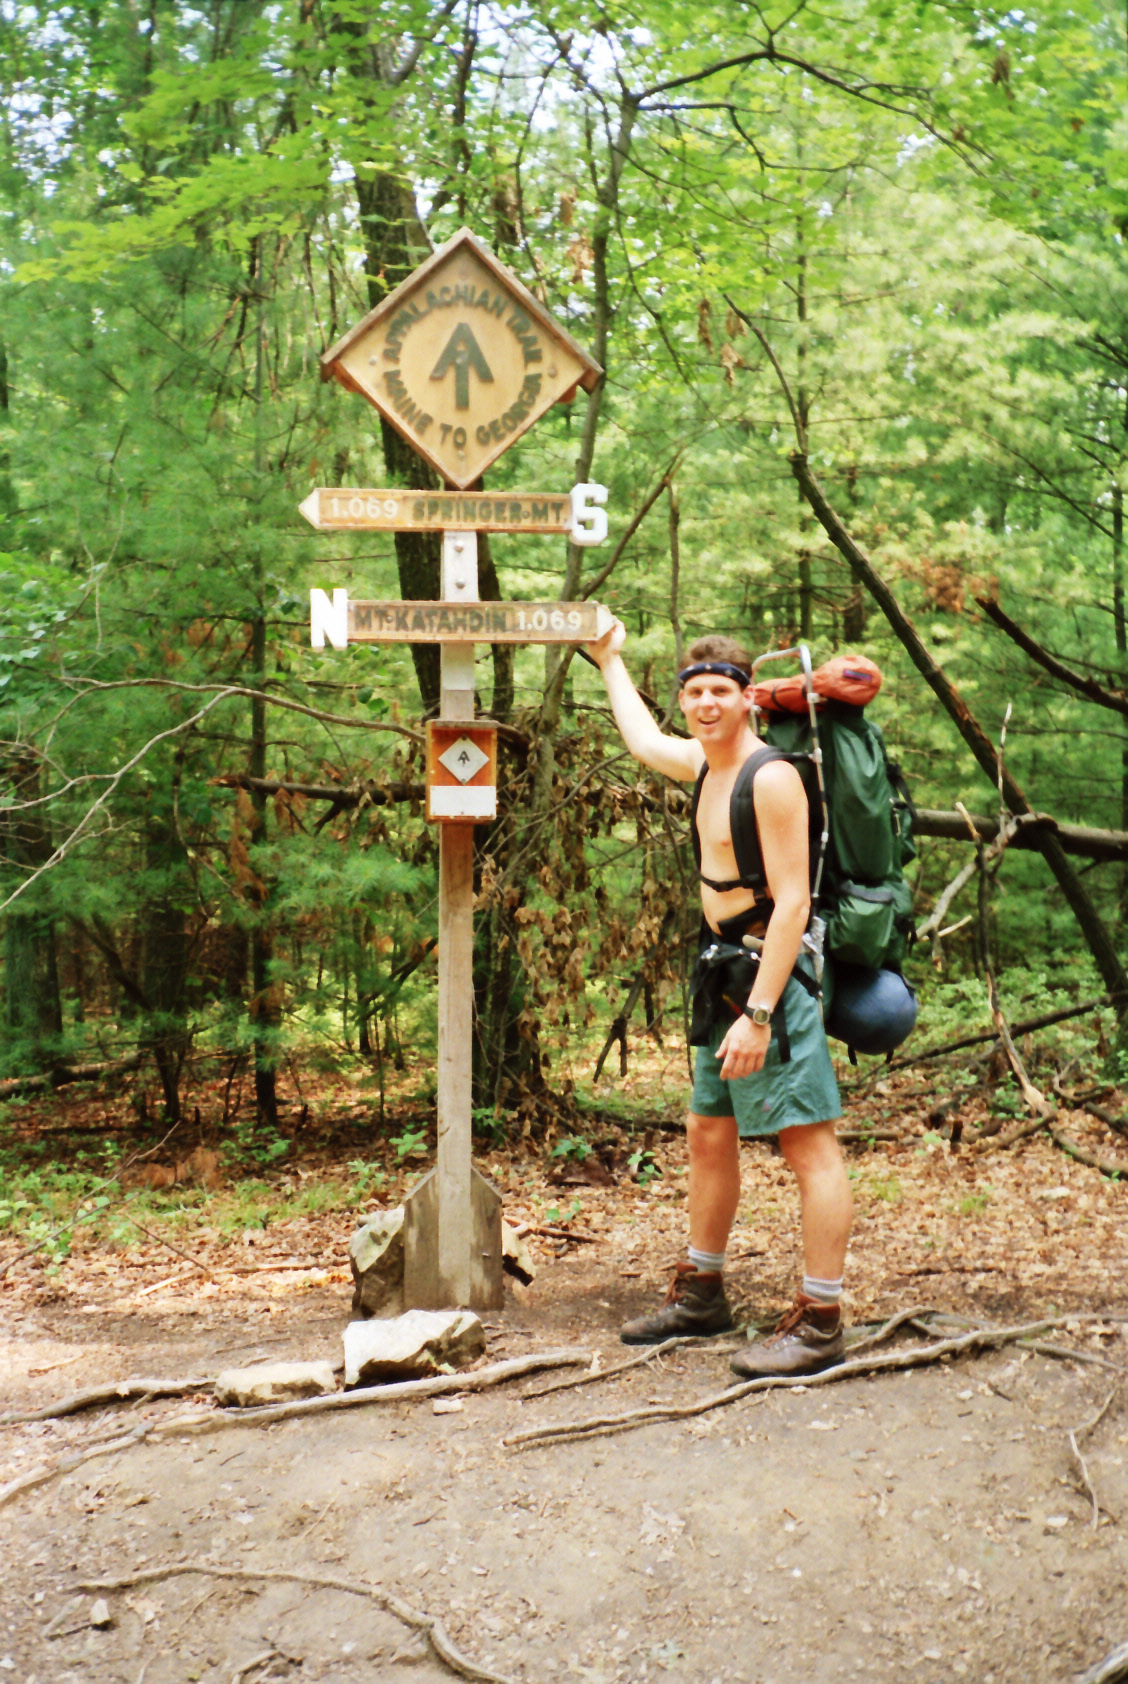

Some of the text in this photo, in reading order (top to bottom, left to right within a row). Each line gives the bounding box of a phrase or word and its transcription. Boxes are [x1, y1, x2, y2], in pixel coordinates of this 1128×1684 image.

[505, 303, 543, 369] TRAIL
[383, 369, 543, 447] MAINE TO GEORGIA
[412, 499, 523, 523] SPRINGER
[310, 588, 348, 653] N
